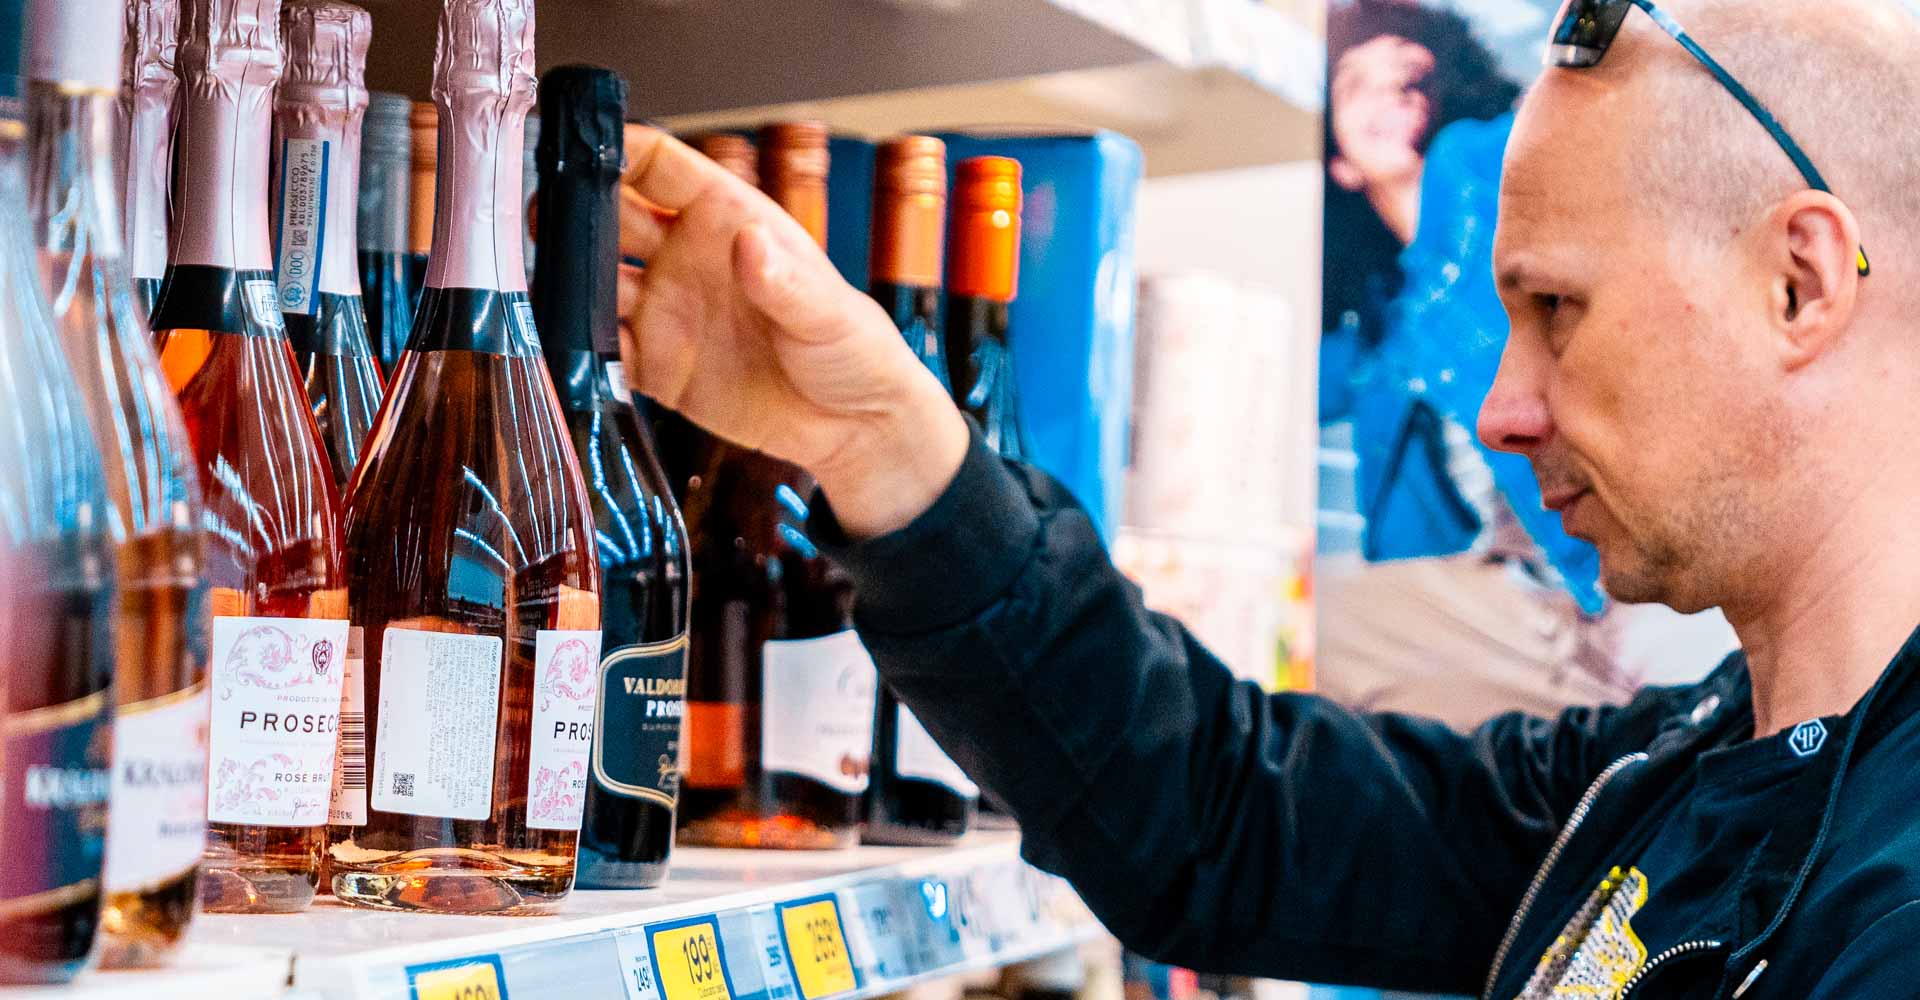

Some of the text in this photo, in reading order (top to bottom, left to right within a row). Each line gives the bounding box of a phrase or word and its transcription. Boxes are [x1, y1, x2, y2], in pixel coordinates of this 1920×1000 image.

[289, 167, 300, 226] PROSECCO
[289, 253, 305, 275] DOC
[682, 933, 713, 985] 199
[633, 967, 651, 992] 249
